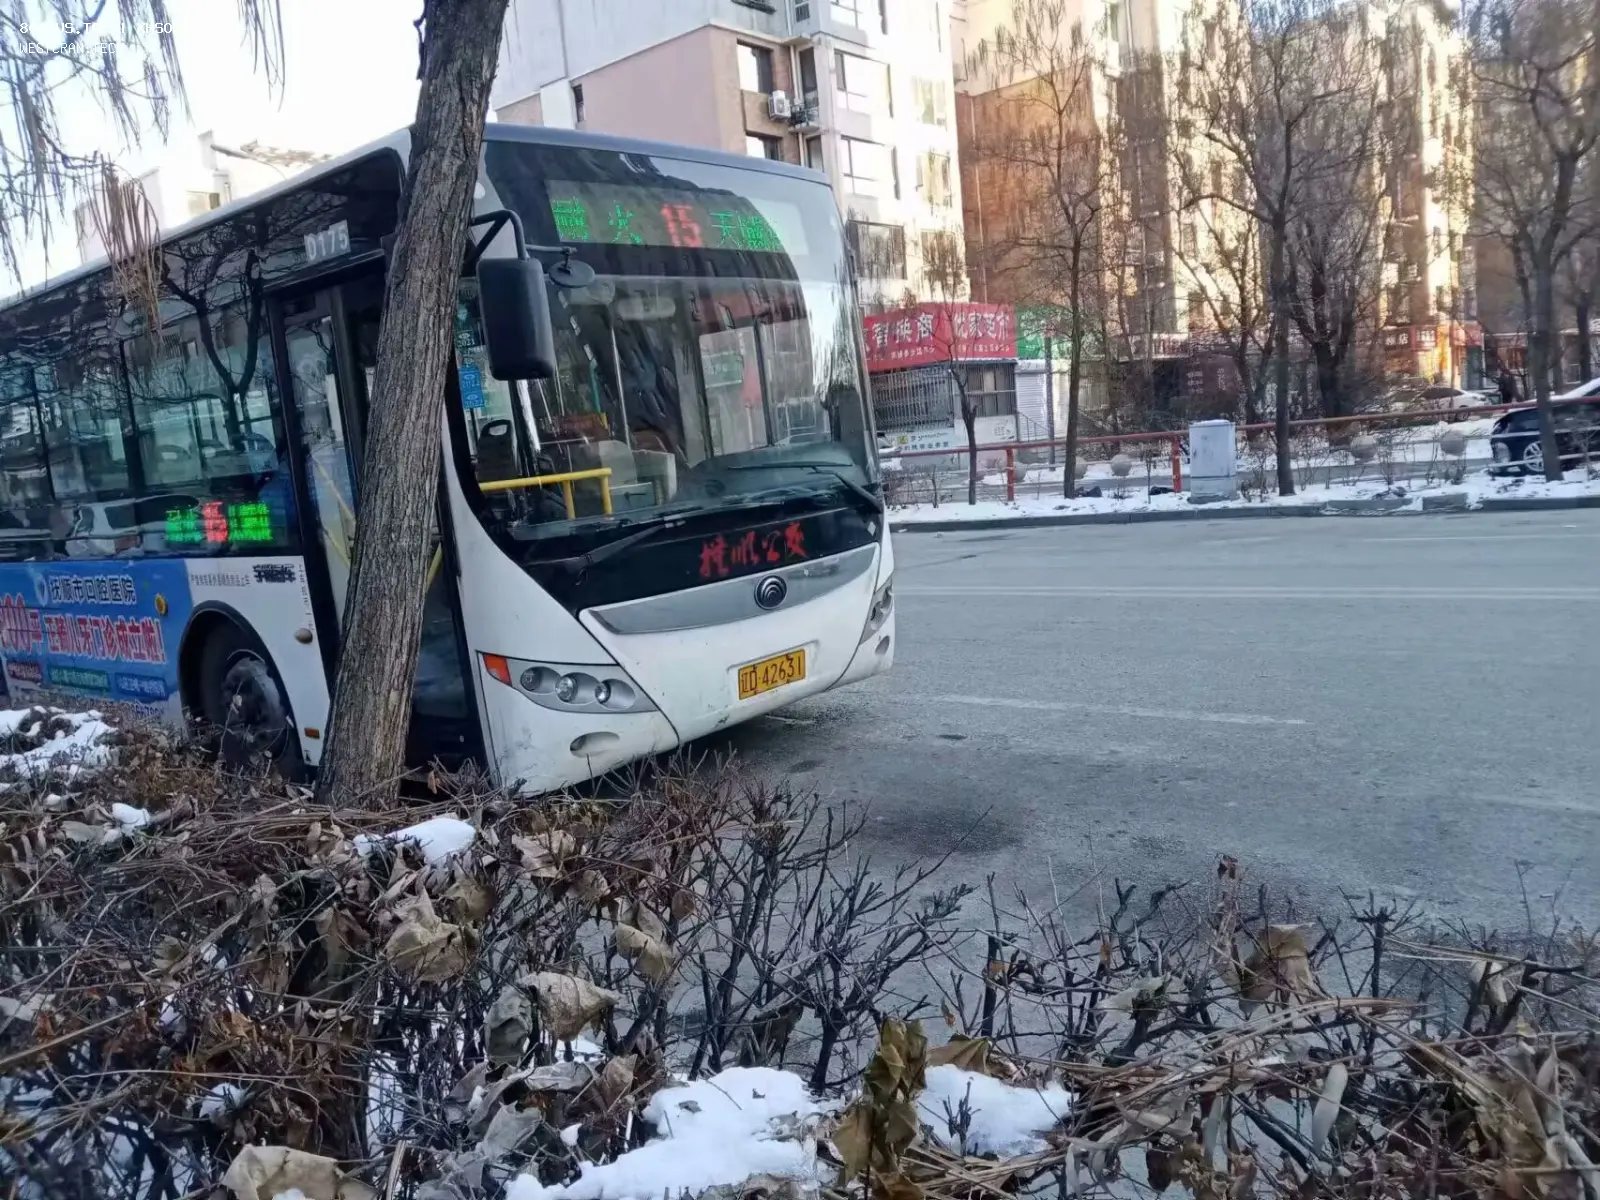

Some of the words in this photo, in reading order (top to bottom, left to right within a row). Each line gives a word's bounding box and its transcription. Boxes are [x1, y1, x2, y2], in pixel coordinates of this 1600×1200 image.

[661, 204, 703, 248] 15
[49, 575, 137, 605] 抚顺市口腔医院
